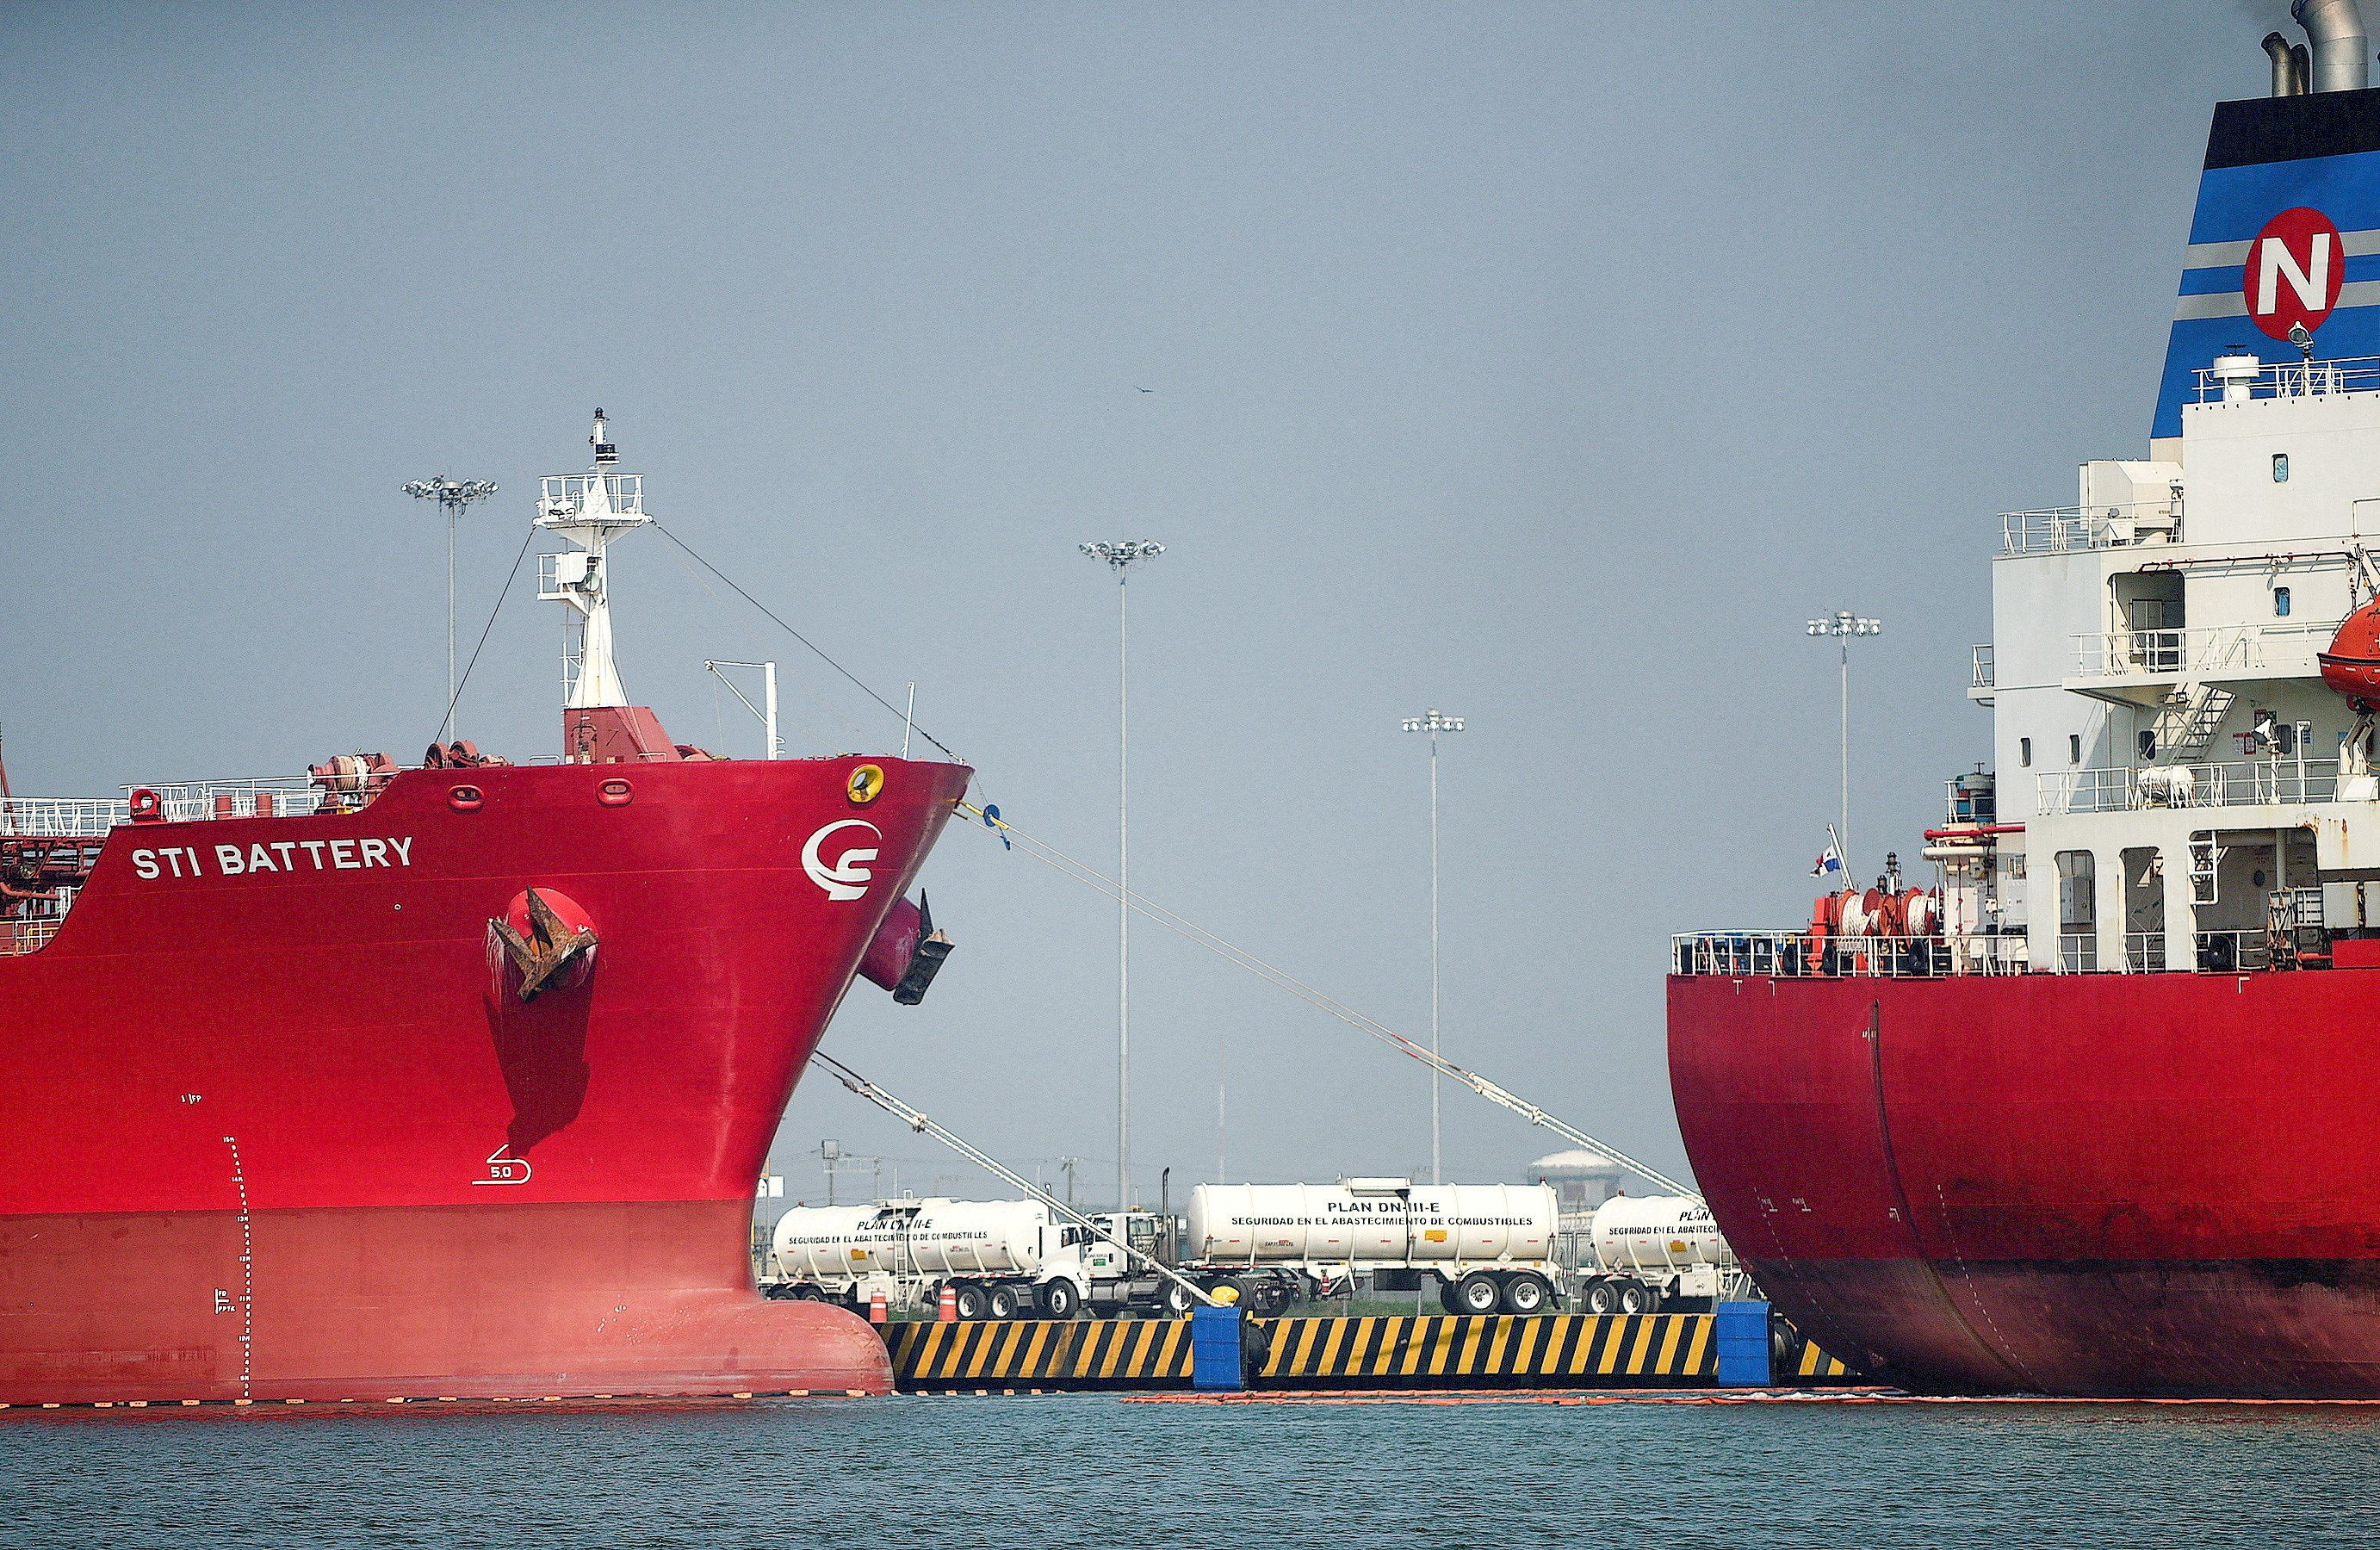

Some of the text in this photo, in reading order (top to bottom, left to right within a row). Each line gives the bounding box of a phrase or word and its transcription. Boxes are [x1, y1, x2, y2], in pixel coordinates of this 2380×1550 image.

[2257, 232, 2331, 315] N
[132, 836, 412, 879] STI BATTERY
[490, 1165, 512, 1178] 5.0
[1328, 1202, 1373, 1212] PLAN
[1231, 1216, 1533, 1225] SEGURIDAD EN EL ABASTECIMIENTO DE COMBUSTIBLES
[1679, 1210, 1711, 1222] PLAN
[1609, 1226, 1652, 1236] SEGURIDAD
[1666, 1225, 1676, 1234] EL
[789, 1236, 830, 1244] SEGURIDAD
[843, 1235, 852, 1243] EL
[920, 1232, 930, 1241] DE
